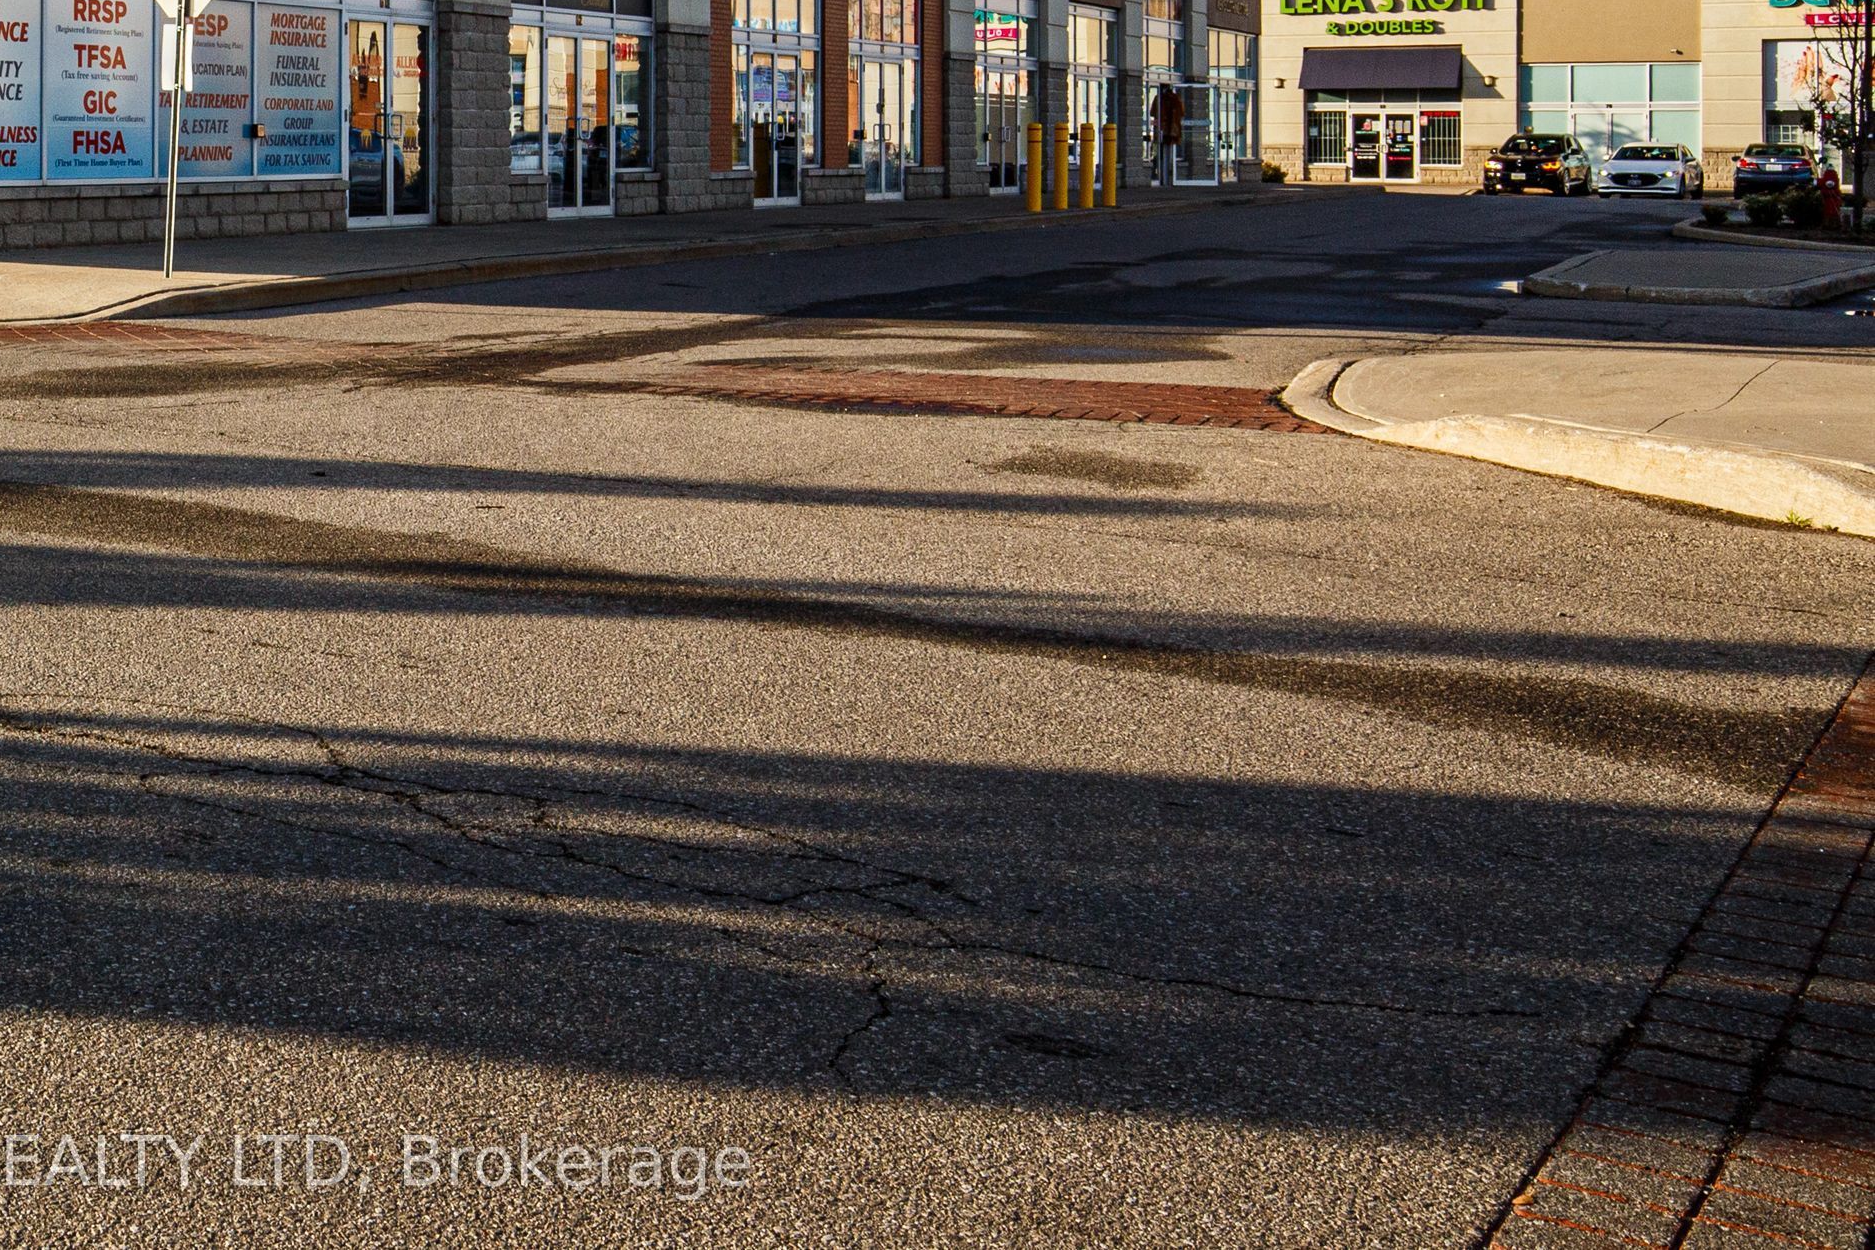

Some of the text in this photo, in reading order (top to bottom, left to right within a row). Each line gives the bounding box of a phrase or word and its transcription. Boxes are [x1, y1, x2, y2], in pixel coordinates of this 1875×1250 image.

[270, 12, 327, 31] MORTGAGE
[1325, 19, 1435, 35] & DOUBLES
[270, 30, 327, 48] INSURANCE
[73, 43, 127, 70] TFSA
[276, 55, 321, 71] FUNERAL
[61, 70, 76, 80] (Tax
[111, 72, 139, 82] Account)
[269, 73, 327, 88] INSURANCE
[83, 89, 118, 115] GIC
[158, 92, 249, 110] TA RETIREMENT
[264, 97, 334, 111] CORPORATE AND
[180, 119, 229, 134] & ESTATE
[283, 117, 314, 130] GROUP
[72, 130, 127, 155] FHSA
[259, 133, 336, 147] INSURANCE PLANS
[178, 145, 233, 162] PLANNING
[264, 153, 331, 167] FOR TAX SAVING
[127, 158, 144, 167] Plan)
